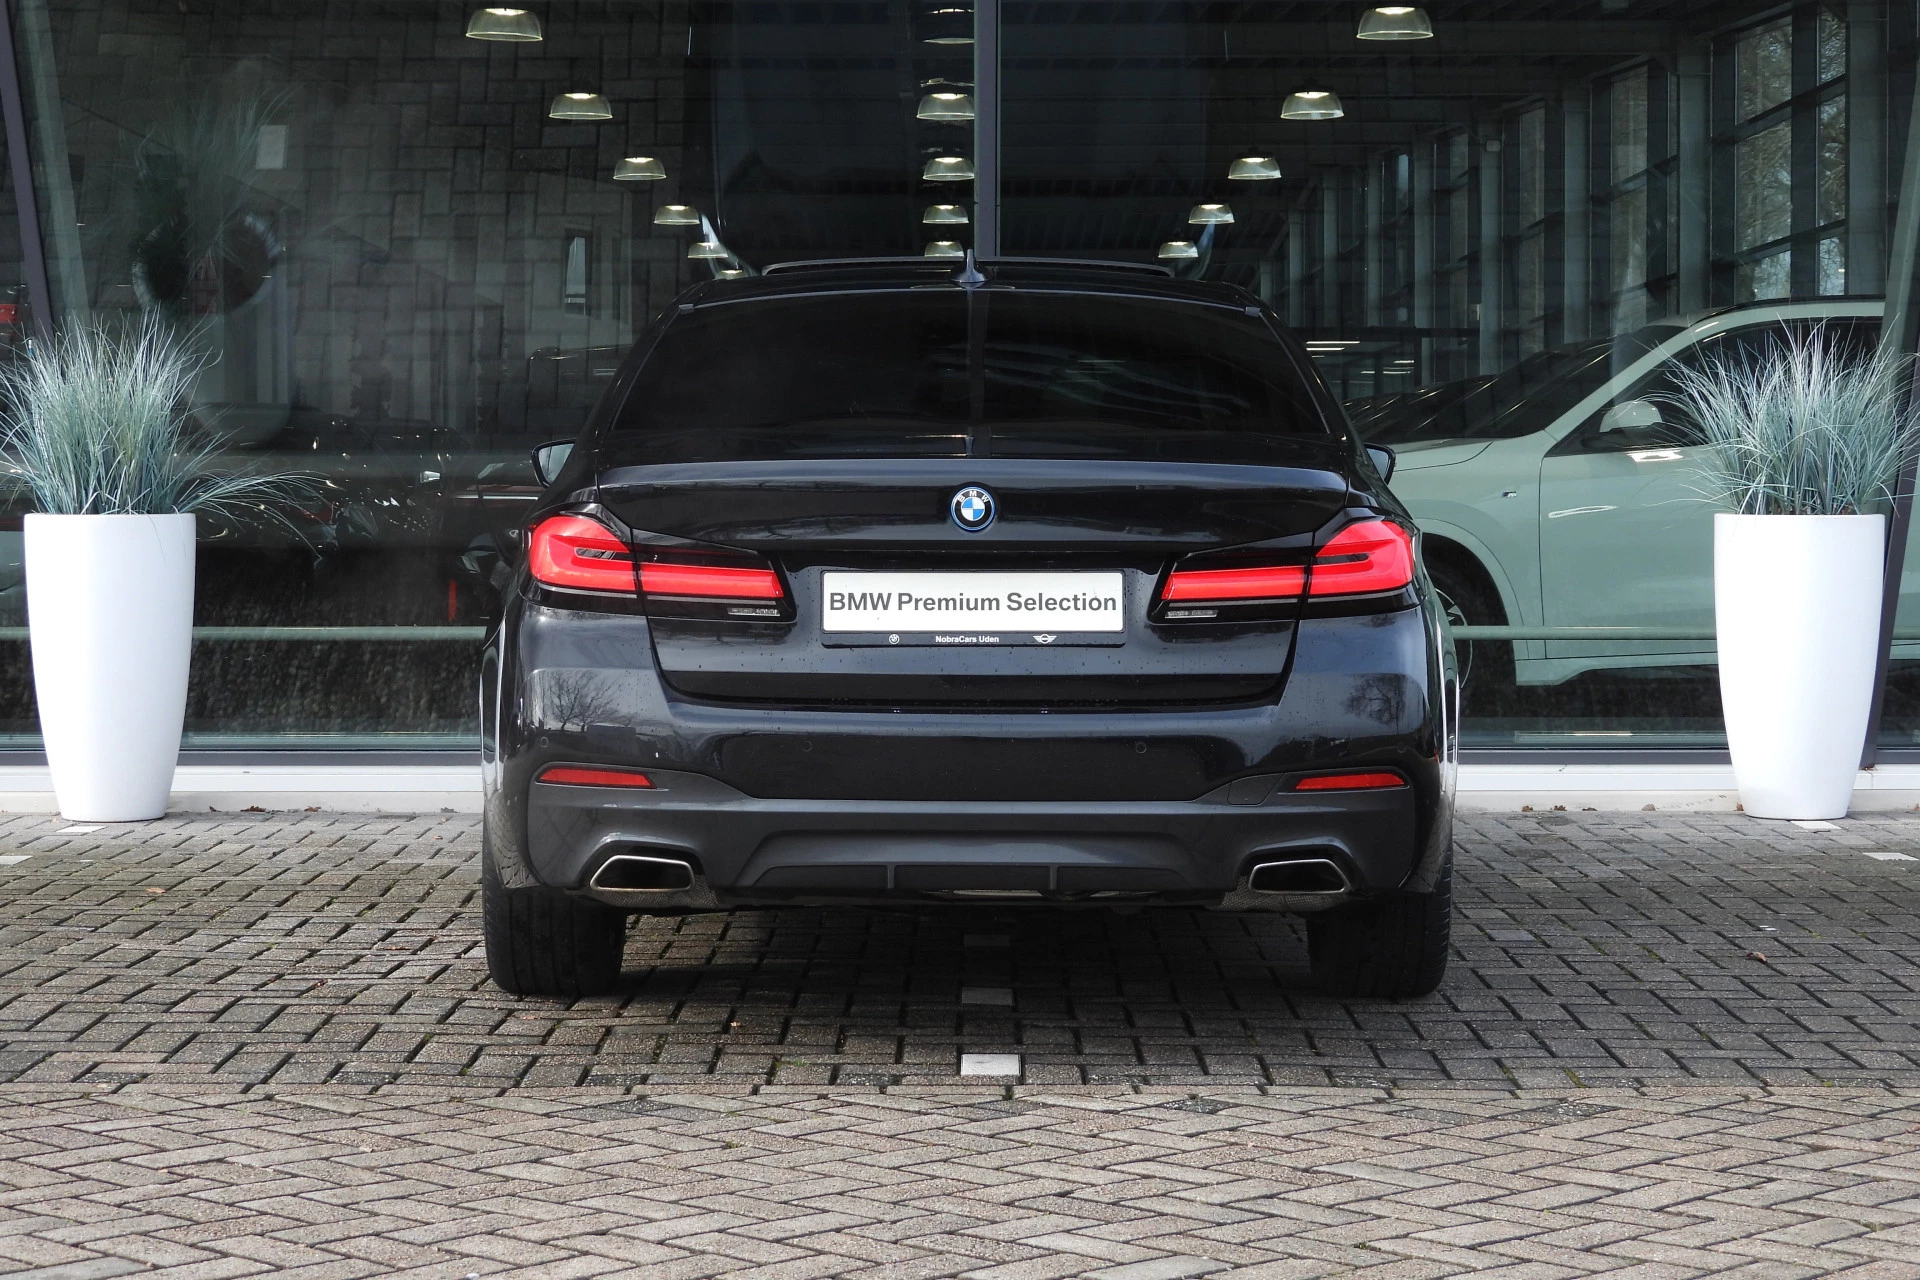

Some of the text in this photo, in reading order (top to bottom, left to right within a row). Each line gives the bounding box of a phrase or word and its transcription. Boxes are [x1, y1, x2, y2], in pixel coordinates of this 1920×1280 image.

[957, 490, 990, 503] BMW
[829, 592, 1117, 612] BMW Premium Selection
[935, 635, 1000, 643] NobraCars Uden
